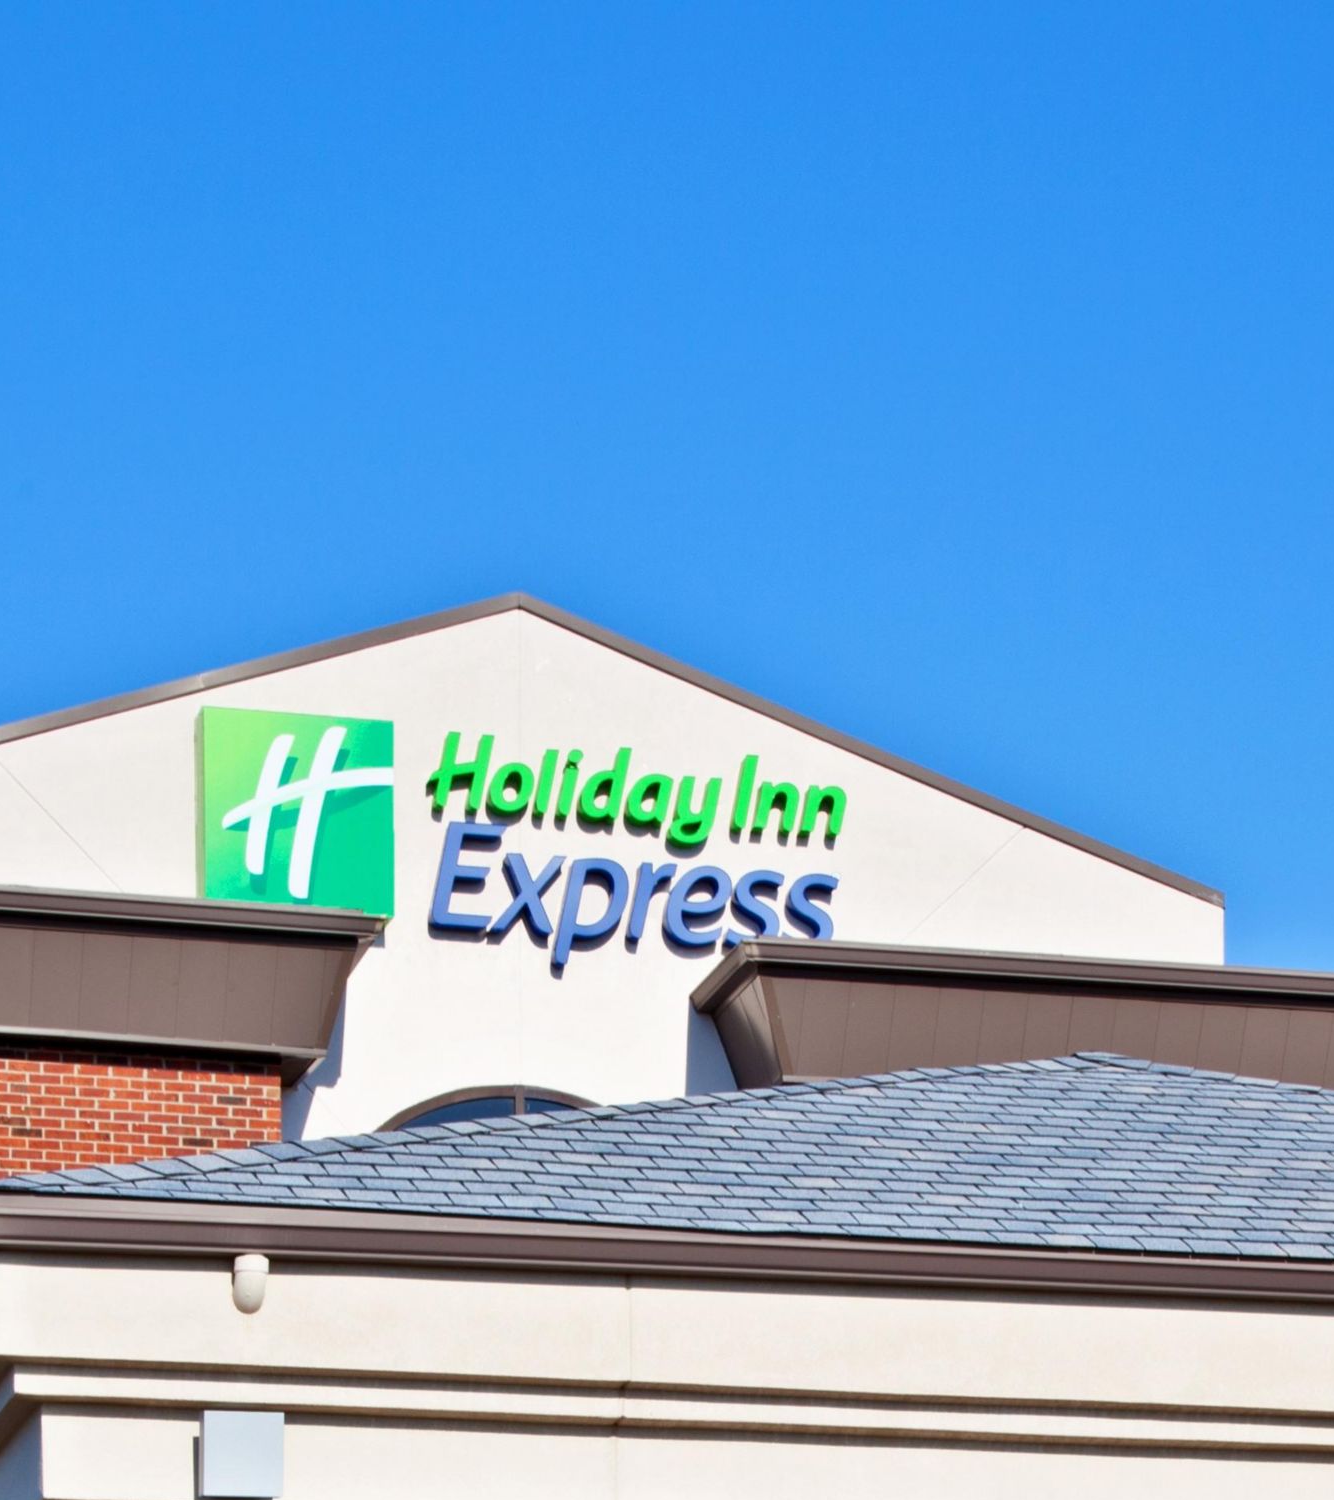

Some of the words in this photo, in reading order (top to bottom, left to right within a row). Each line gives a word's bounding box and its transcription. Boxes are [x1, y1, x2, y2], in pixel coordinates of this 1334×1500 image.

[426, 731, 722, 846] Holiday
[730, 755, 847, 840] Inn
[428, 821, 838, 970] Express
